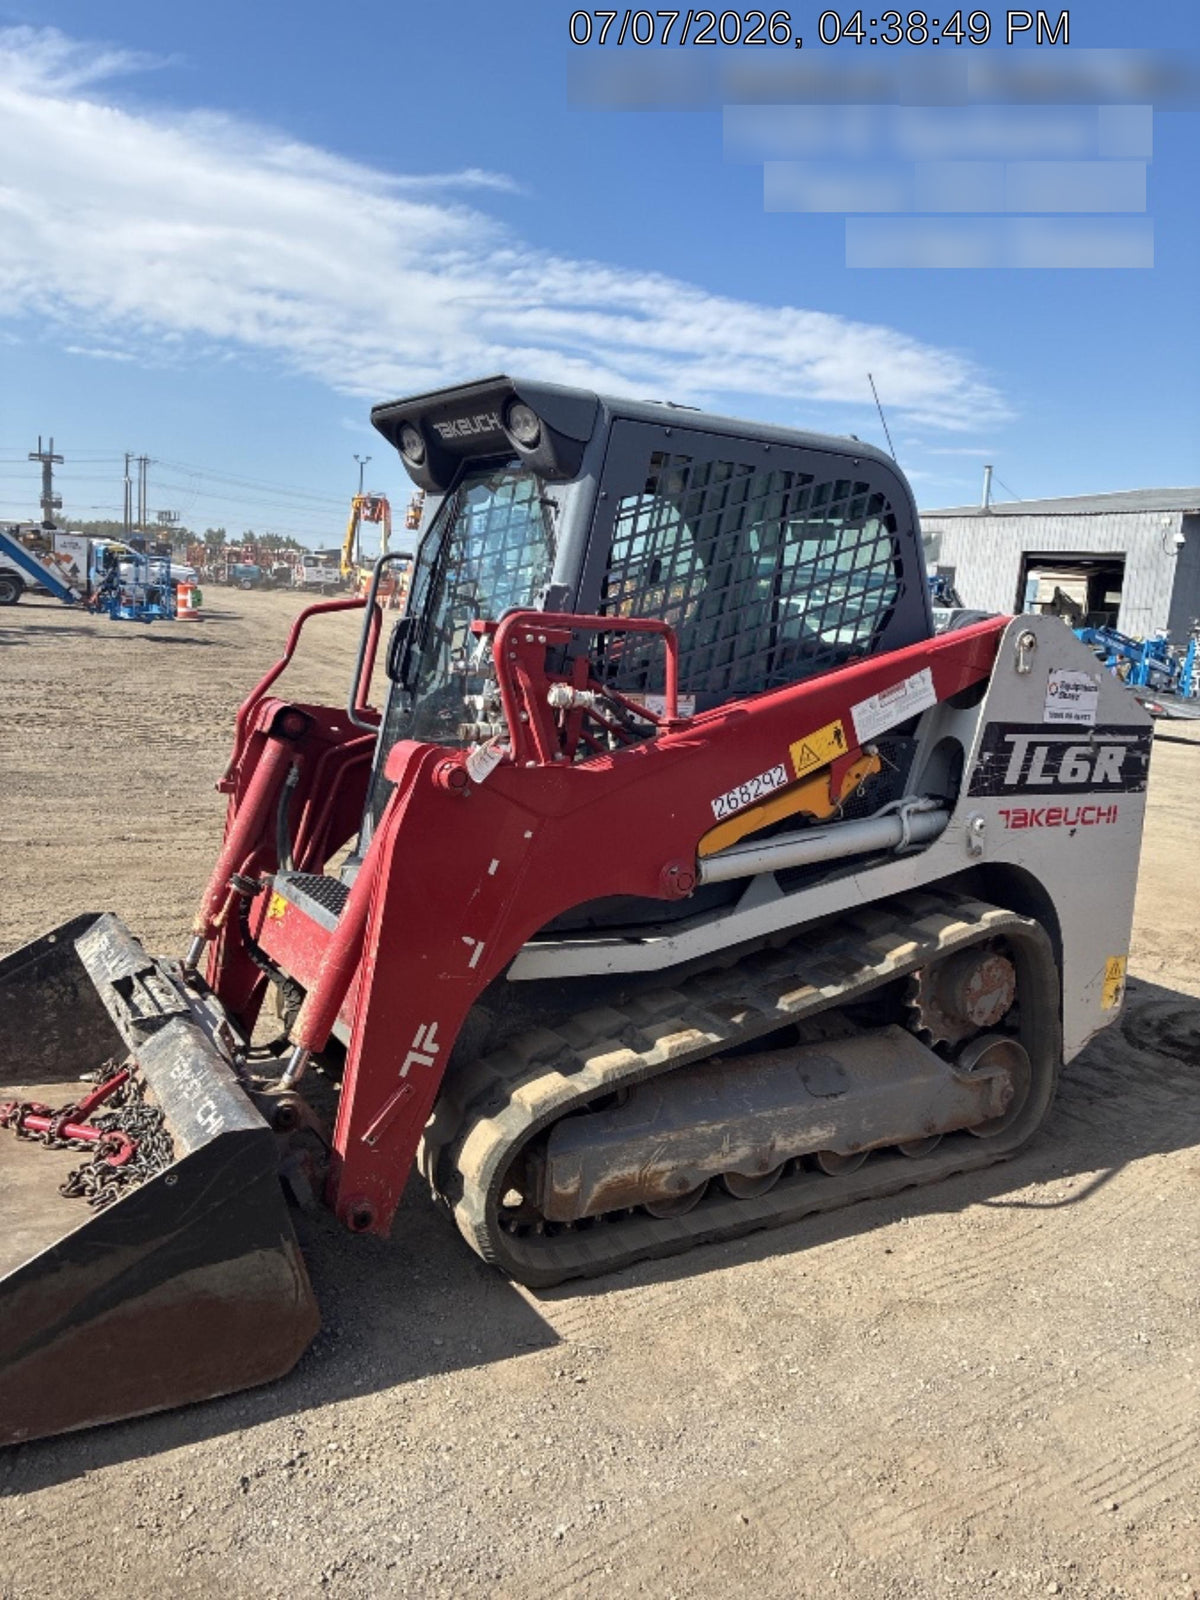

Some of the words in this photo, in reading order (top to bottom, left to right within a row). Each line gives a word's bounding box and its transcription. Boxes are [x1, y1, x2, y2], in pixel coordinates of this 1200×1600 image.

[432, 412, 503, 438] TAKEUCH
[1004, 733, 1138, 785] TL6R
[714, 765, 787, 818] 268292
[998, 805, 1117, 829] TAKEUCHI
